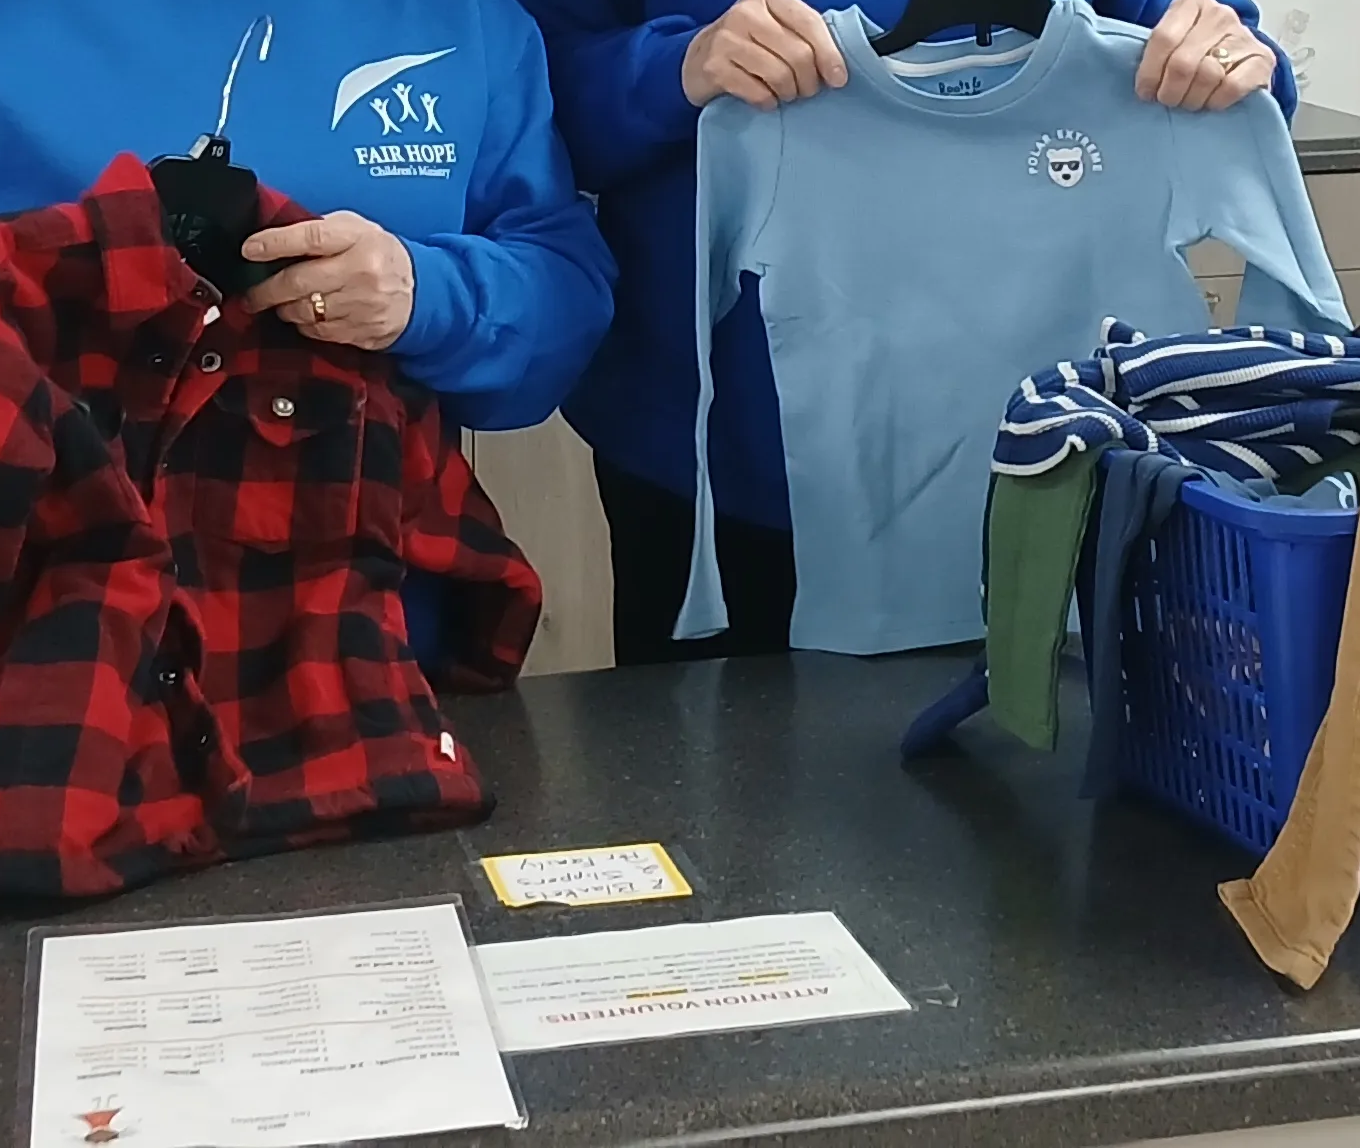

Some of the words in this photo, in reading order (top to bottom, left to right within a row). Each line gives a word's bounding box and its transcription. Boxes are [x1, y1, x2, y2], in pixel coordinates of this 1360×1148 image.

[354, 146, 405, 164] FAIR
[404, 143, 457, 164] HOPE
[1028, 134, 1051, 174] POLAR
[1056, 129, 1103, 171] EXTREME
[369, 165, 418, 177] Children's
[520, 856, 595, 870] Family
[517, 870, 623, 886] Slippers
[705, 986, 829, 1007] ATTENTION
